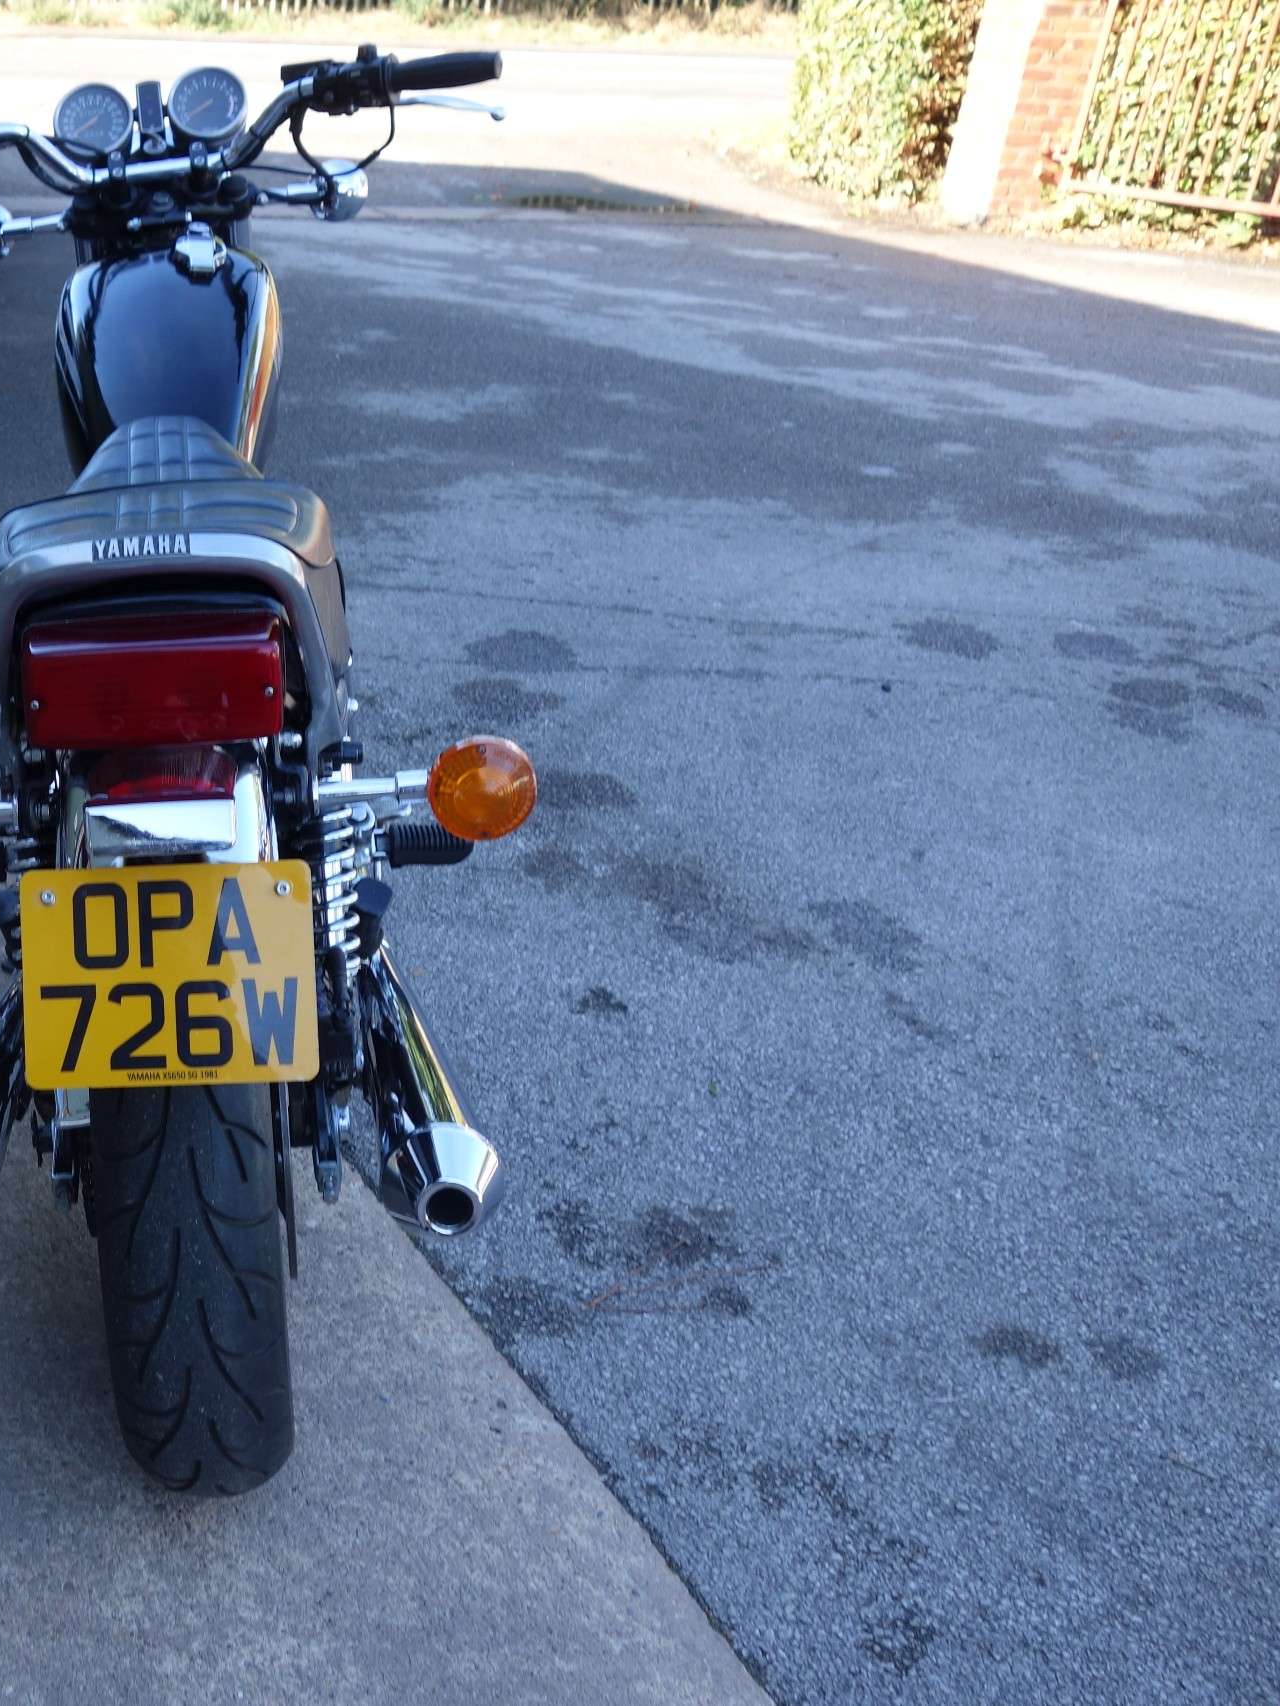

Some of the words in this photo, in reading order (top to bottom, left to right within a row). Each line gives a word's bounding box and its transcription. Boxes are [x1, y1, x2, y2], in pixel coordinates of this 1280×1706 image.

[95, 533, 187, 560] YAMAHA
[72, 877, 261, 970] OPA
[40, 976, 298, 1073] 726W
[127, 1072, 161, 1081] YAMAHA
[162, 1071, 186, 1080] XS650
[200, 1070, 219, 1079] 1981
